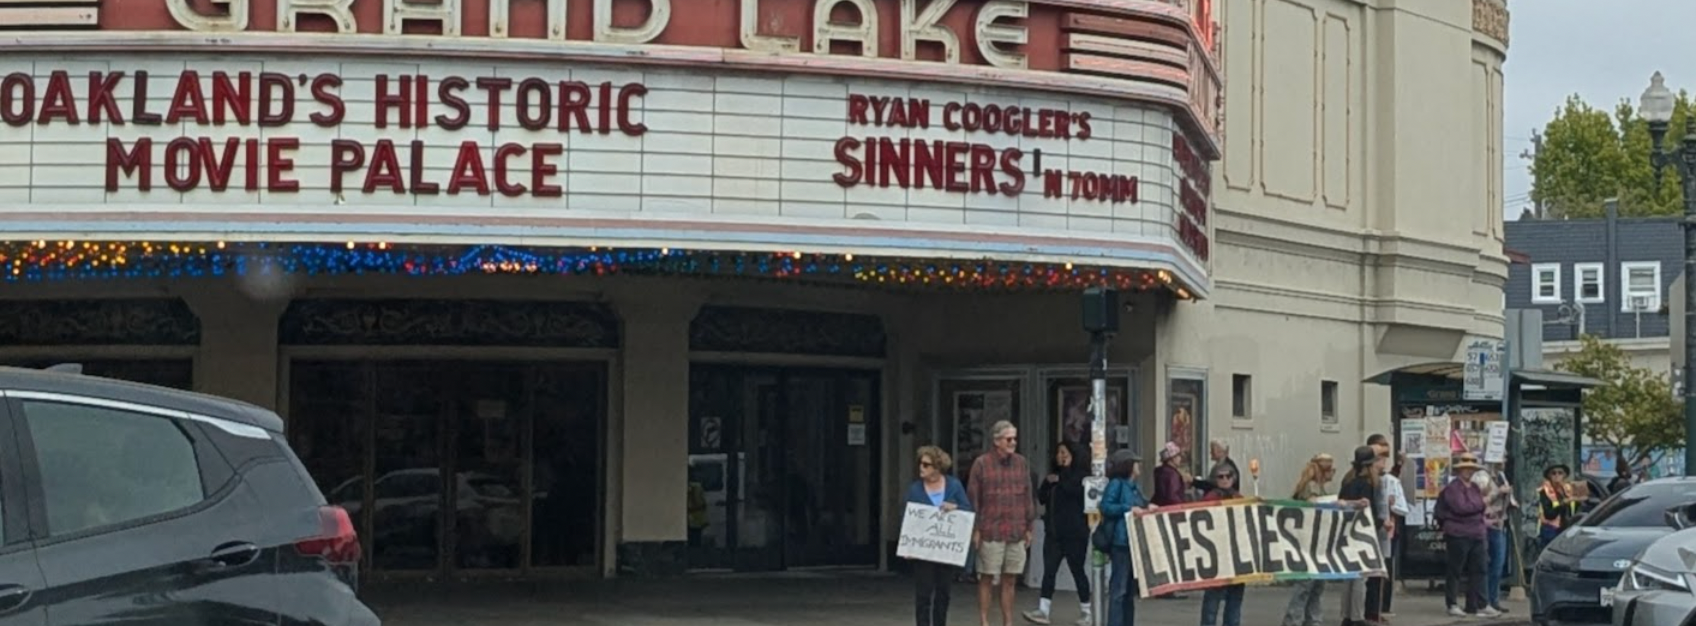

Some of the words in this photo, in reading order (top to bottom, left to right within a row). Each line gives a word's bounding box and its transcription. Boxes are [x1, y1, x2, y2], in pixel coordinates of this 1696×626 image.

[740, 0, 1028, 69] LAKE
[0, 70, 346, 128] OAKLAND'S
[374, 74, 649, 137] HISTORIC
[848, 93, 930, 129] RYAN
[943, 101, 1092, 141] COOGLER'S
[105, 136, 300, 193] MOVIE
[330, 139, 564, 198] PALACE
[832, 136, 1026, 198] SINNERS
[1067, 170, 1138, 204] 70MM
[900, 533, 963, 553] IMMIGRANTS
[908, 507, 926, 519] WE
[928, 510, 957, 525] ARE
[925, 522, 955, 537] ALL
[1134, 509, 1218, 589] LIES
[1226, 504, 1308, 577] LIES
[1310, 506, 1382, 575] LIES
